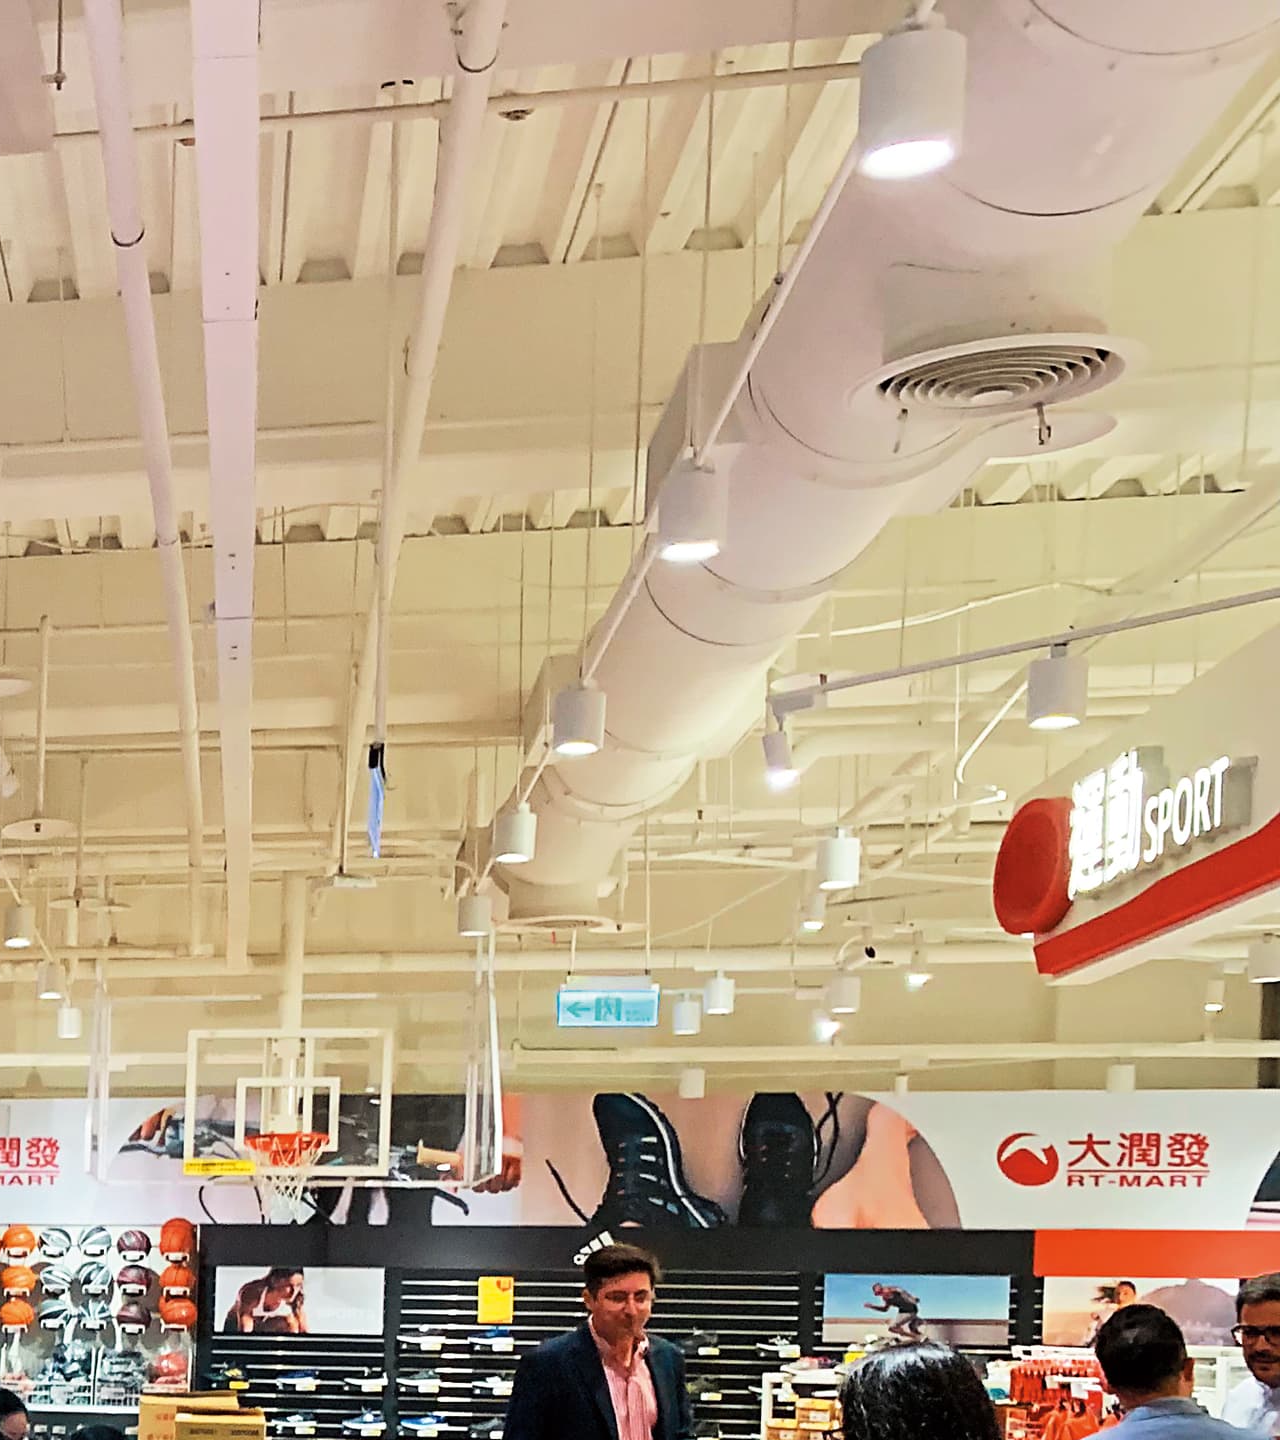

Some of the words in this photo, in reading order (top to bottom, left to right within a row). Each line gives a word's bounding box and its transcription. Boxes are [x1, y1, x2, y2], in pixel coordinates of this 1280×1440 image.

[1143, 756, 1230, 863] SPORT
[1068, 1133, 1209, 1167] 大潤發
[1067, 1174, 1209, 1187] RT-MART
